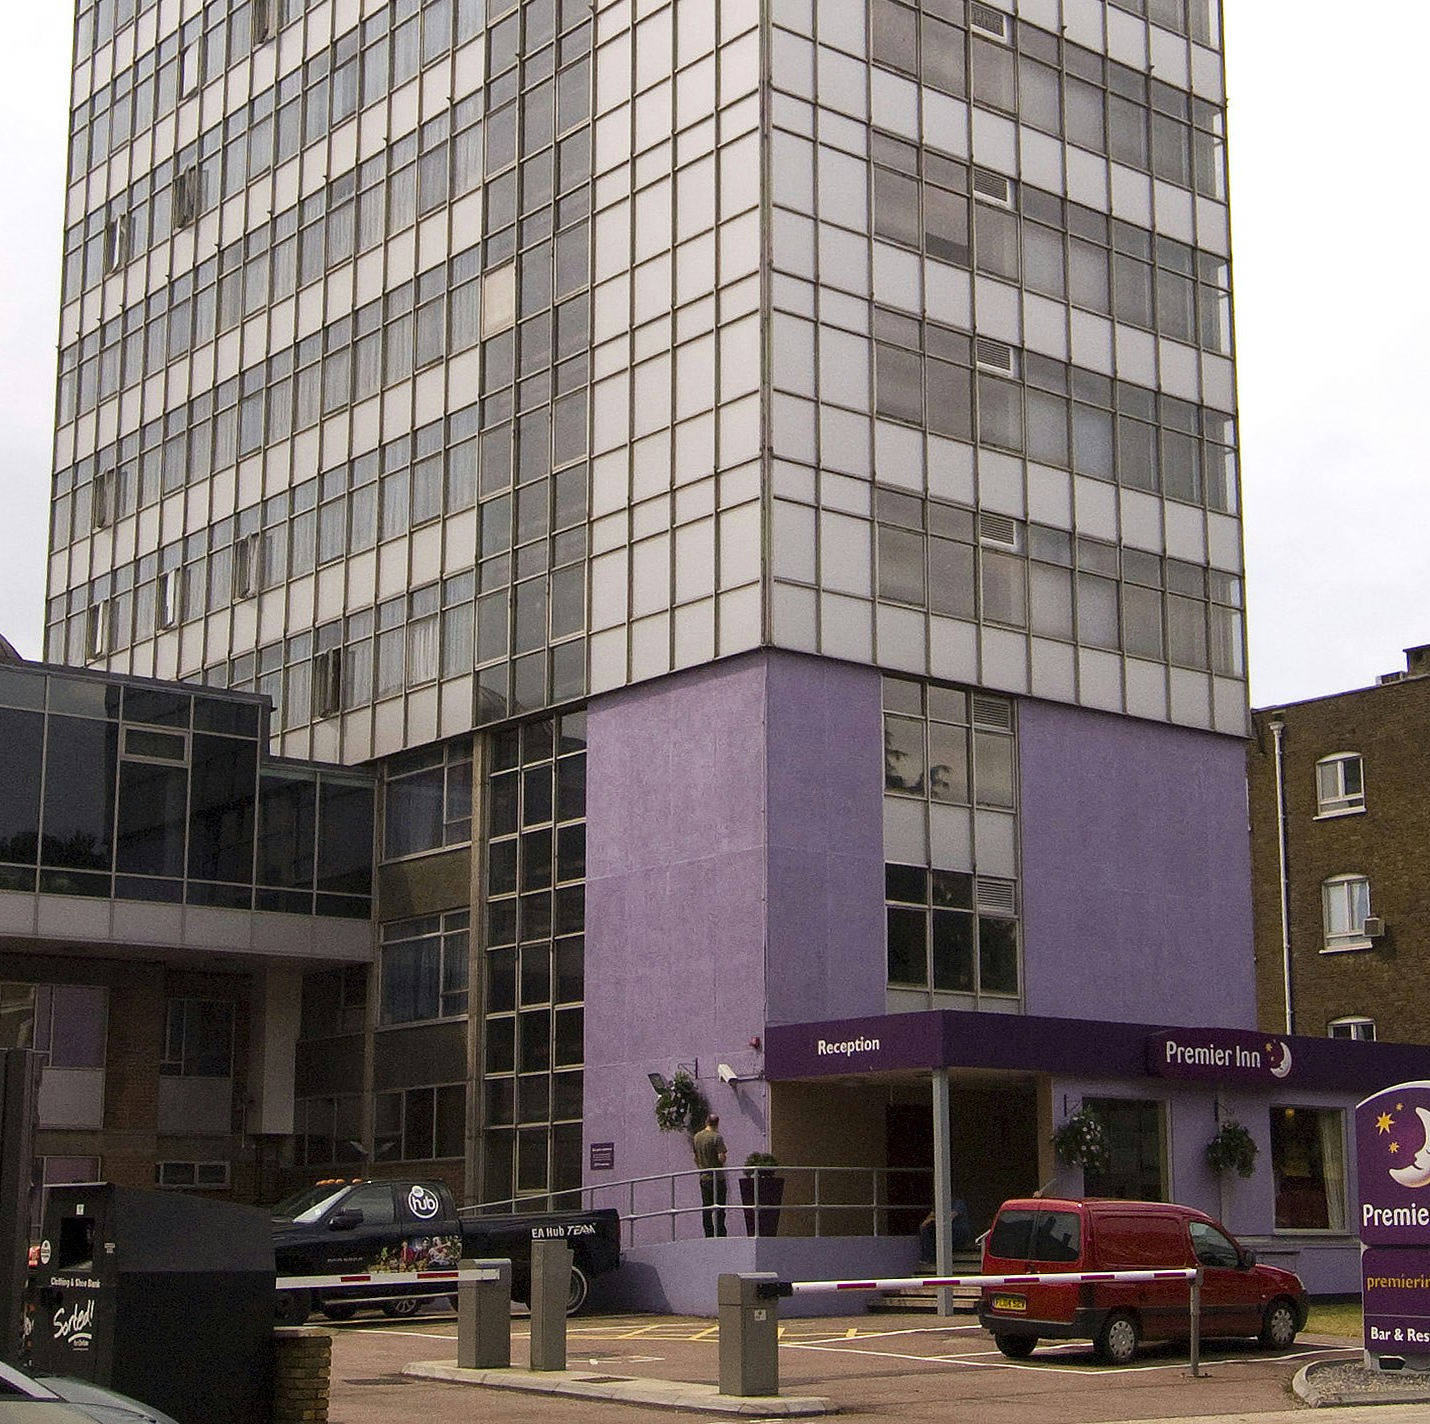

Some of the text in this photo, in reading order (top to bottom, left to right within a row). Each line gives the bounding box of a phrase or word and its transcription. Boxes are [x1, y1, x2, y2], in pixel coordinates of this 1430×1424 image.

[818, 1036, 880, 1056] Reception
[1166, 1041, 1261, 1068] Premier Inn
[412, 1195, 436, 1211] hub
[532, 1224, 596, 1238] EA Hub TEAM
[1371, 1326, 1391, 1340] Bar
[1394, 1328, 1403, 1341] &
